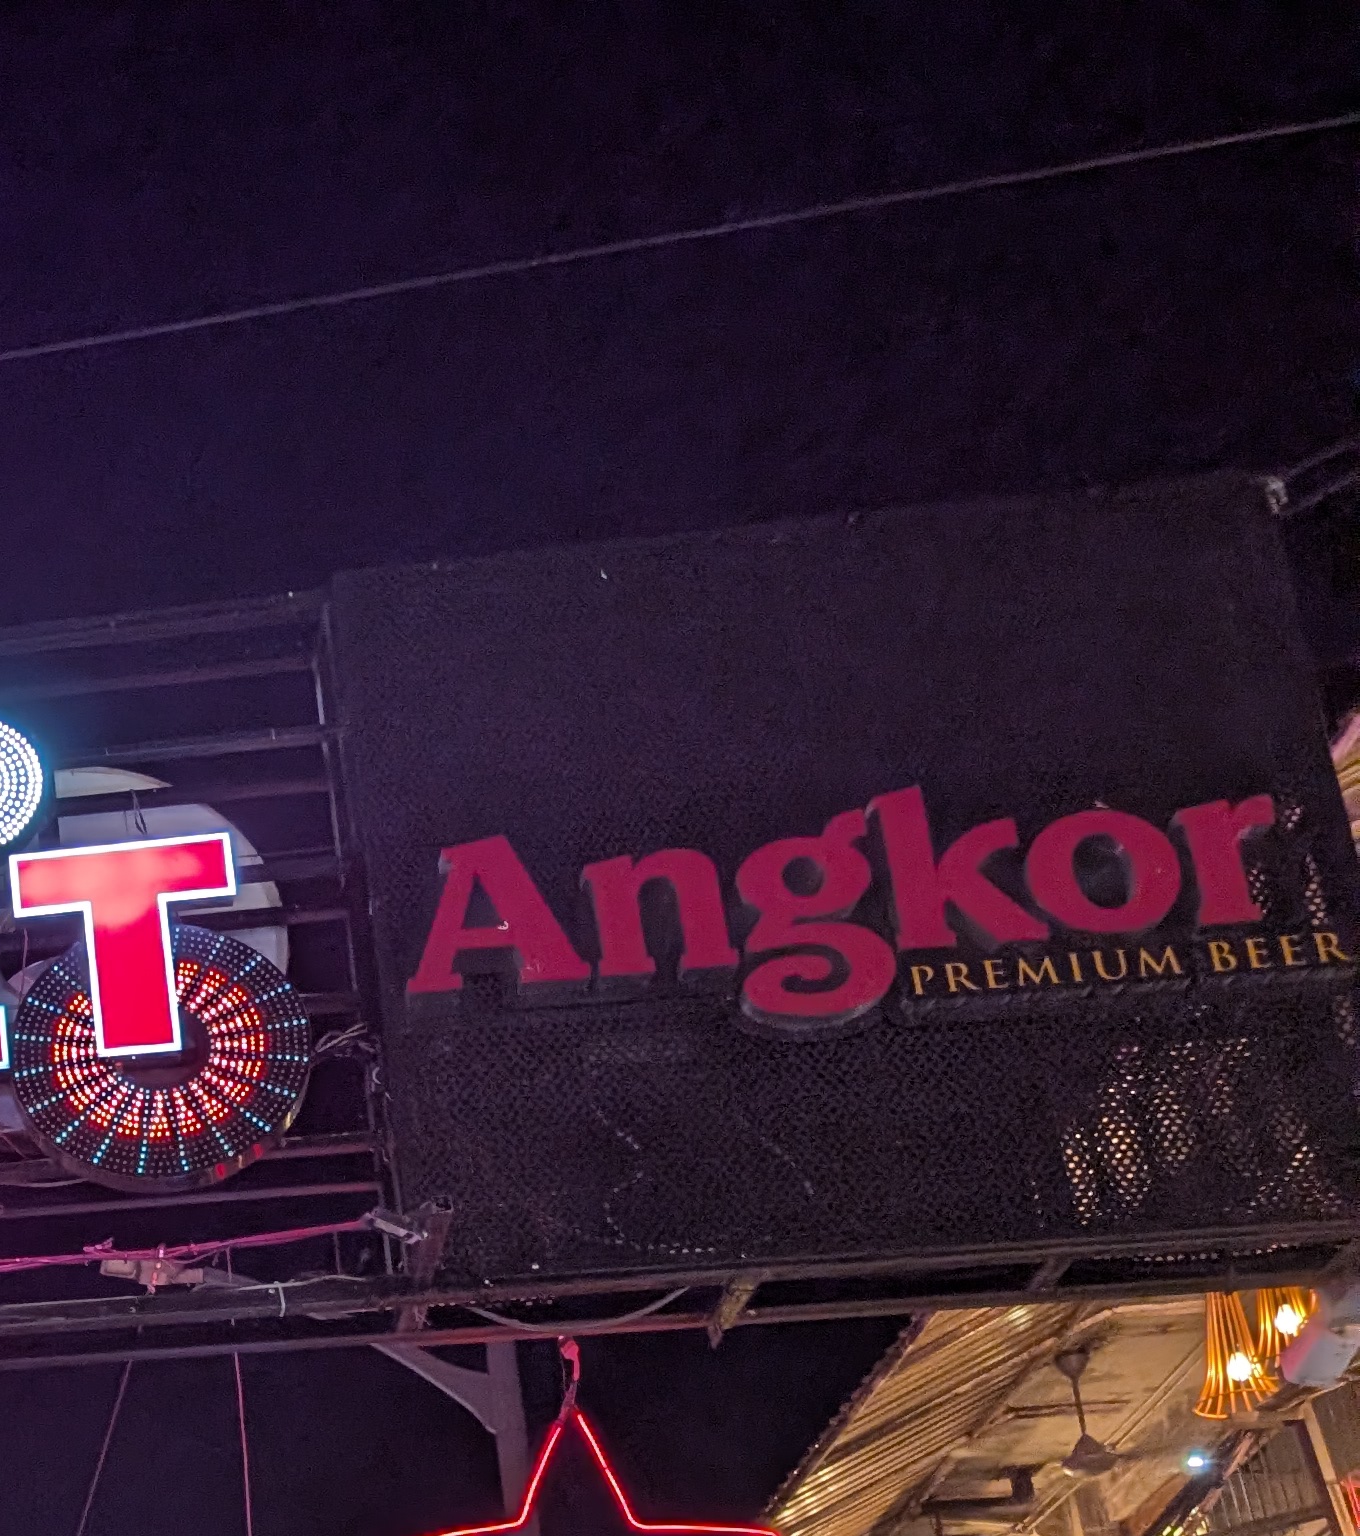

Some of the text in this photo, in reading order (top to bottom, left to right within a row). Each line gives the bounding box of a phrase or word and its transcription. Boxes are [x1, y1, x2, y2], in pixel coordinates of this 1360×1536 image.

[405, 785, 1276, 1018] Angkor
[910, 930, 1354, 997] PREMIUM BEER
